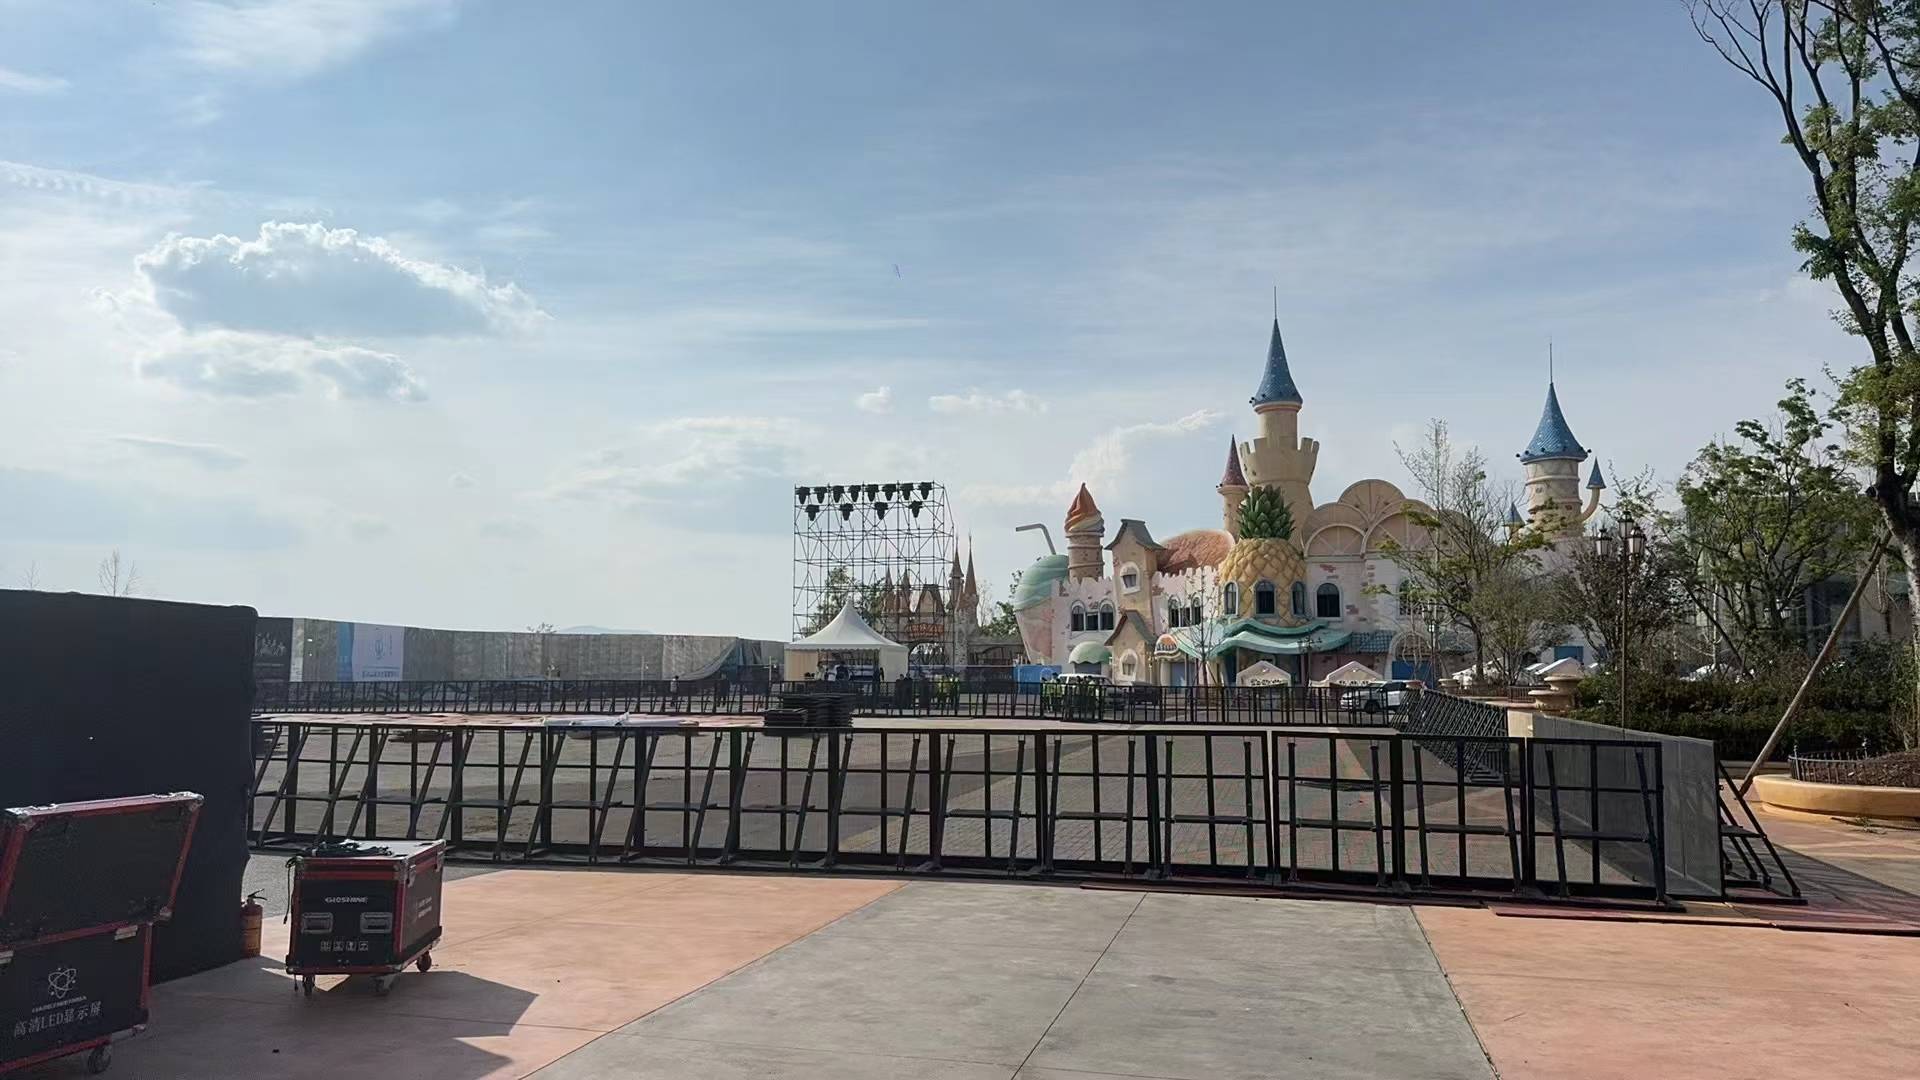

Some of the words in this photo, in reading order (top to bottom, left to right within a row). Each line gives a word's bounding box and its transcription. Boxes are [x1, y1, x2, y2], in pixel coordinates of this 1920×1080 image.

[15, 1001, 101, 1037] 高清LED显示屏
